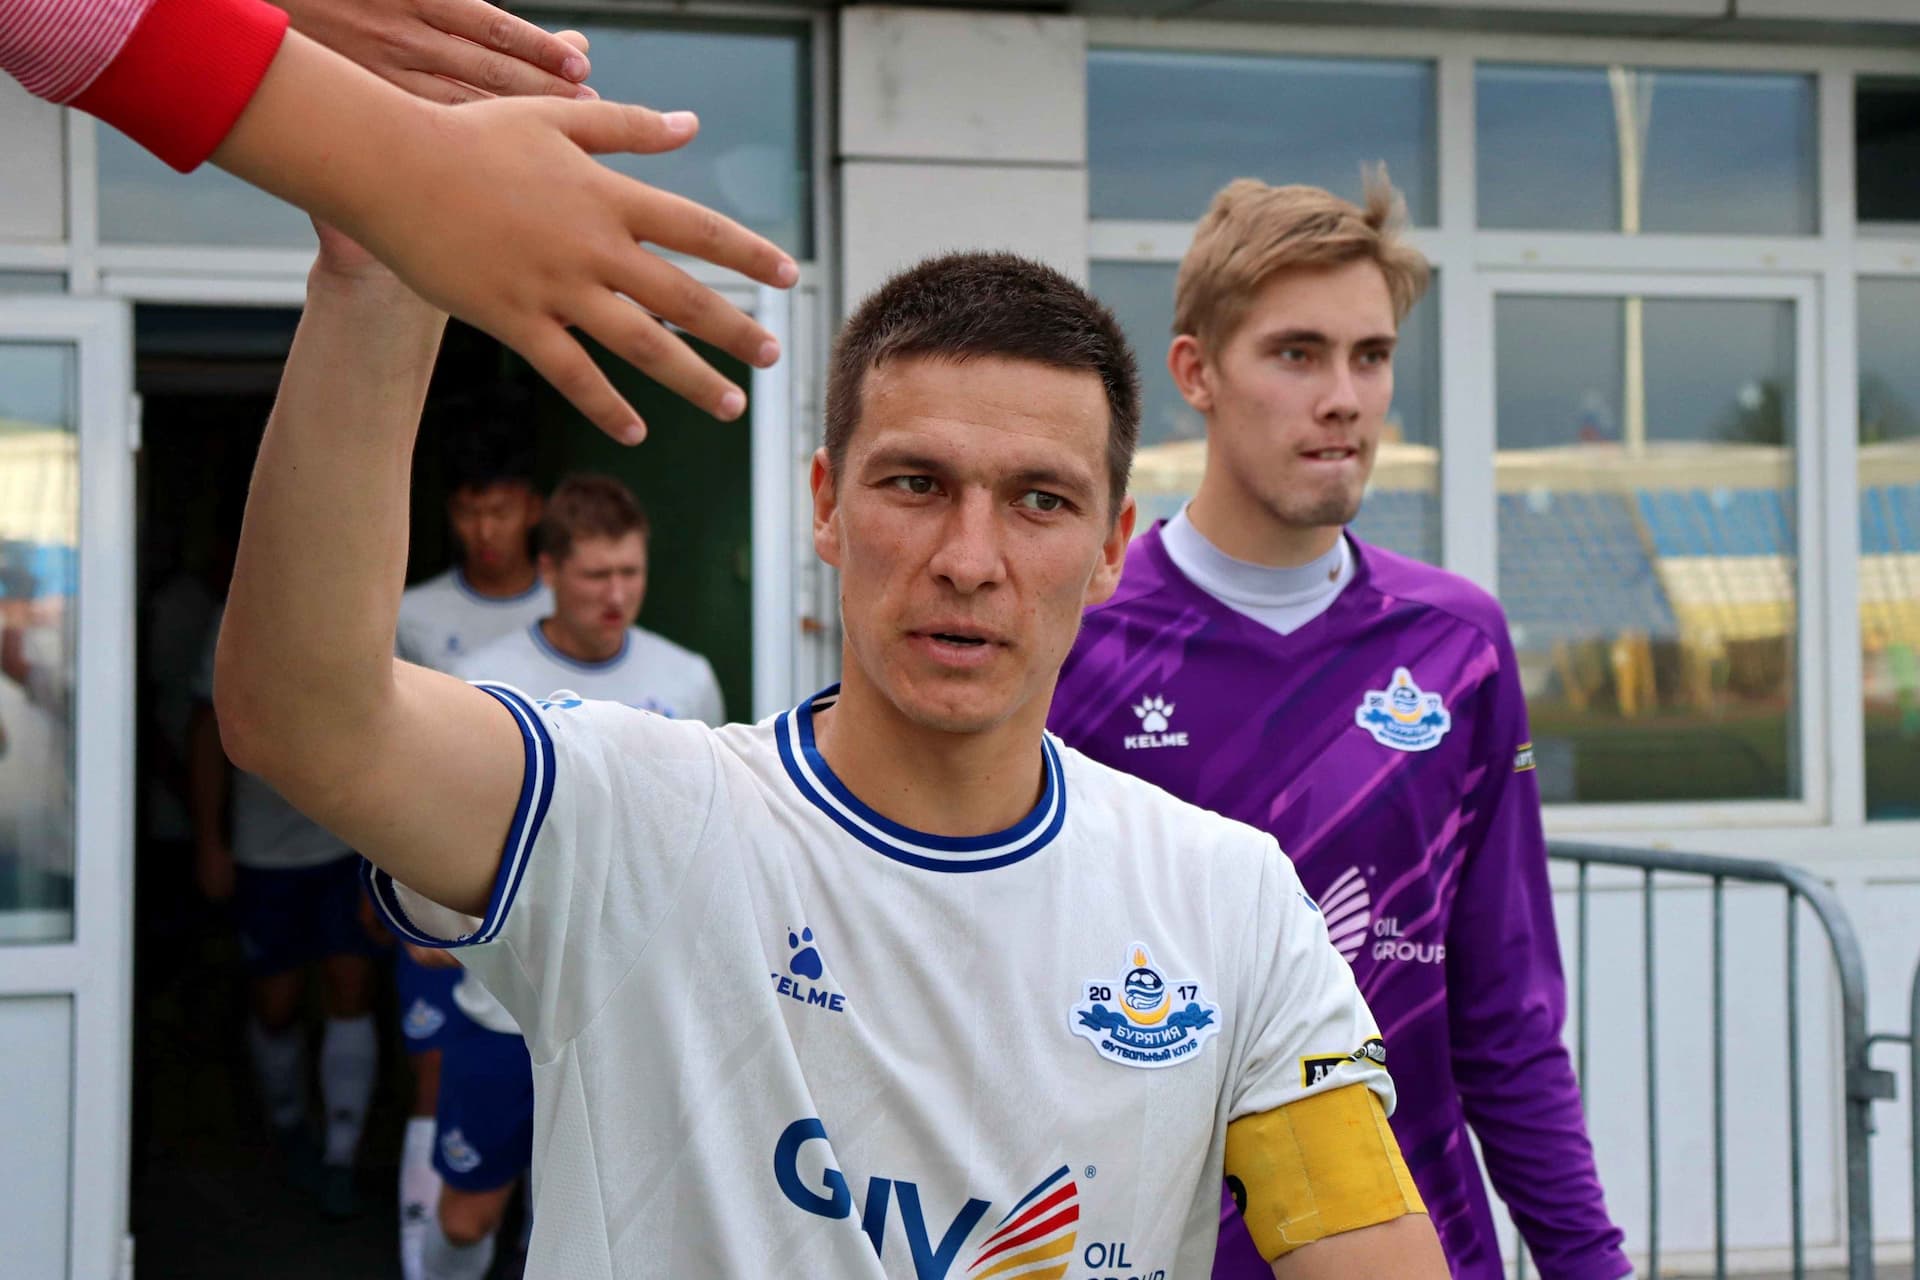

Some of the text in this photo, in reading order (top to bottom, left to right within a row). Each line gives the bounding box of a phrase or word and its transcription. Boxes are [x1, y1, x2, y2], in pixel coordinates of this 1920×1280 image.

[1124, 732, 1189, 750] KELME
[1373, 918, 1405, 938] OIL
[1372, 941, 1446, 965] GROUP
[771, 973, 846, 1013] ELME
[1089, 985, 1198, 1002] 20 17
[1116, 1025, 1182, 1045] БУРЯТИЯ
[1101, 1038, 1198, 1062] ФУТБОЛЬНЫЙ КЛУБ
[1084, 1242, 1132, 1269] OIL
